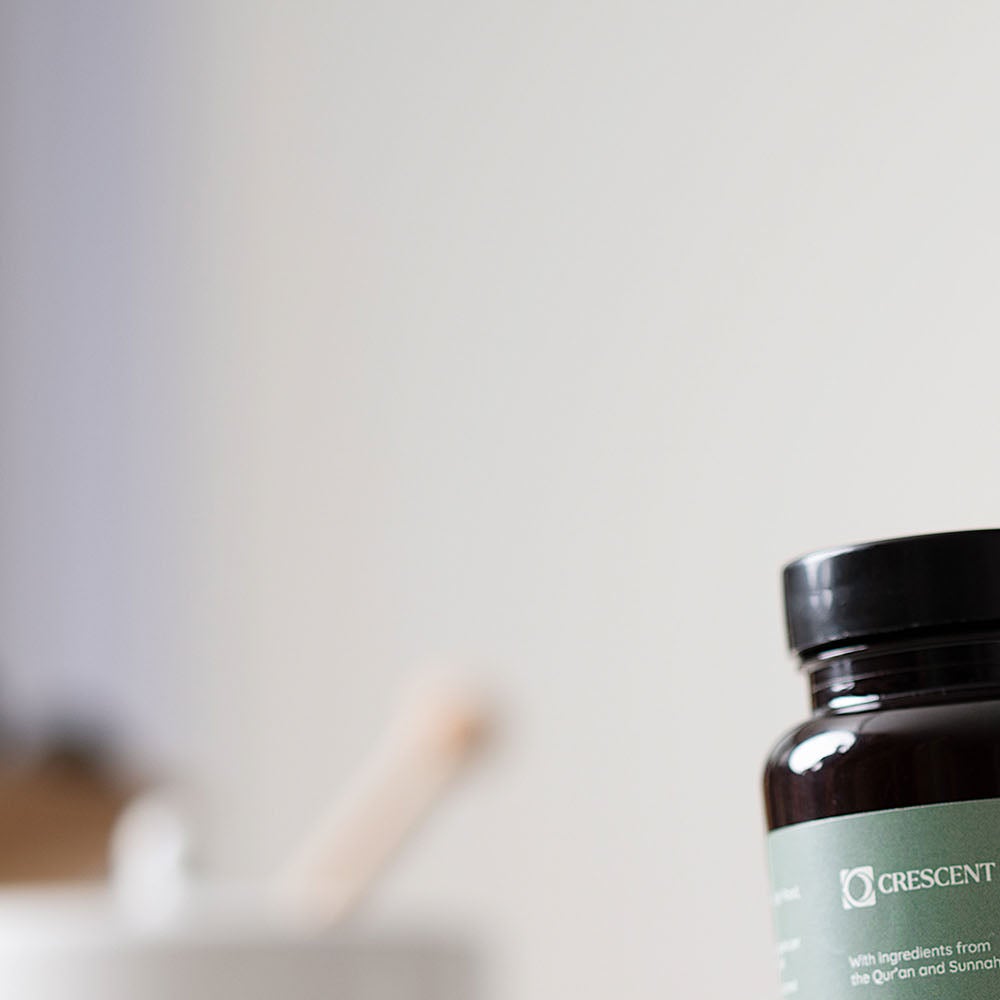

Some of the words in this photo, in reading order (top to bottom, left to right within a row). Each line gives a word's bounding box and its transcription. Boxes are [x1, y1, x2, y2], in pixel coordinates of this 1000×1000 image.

[878, 862, 996, 894] CRESCENT
[878, 944, 953, 966] ingredients
[956, 941, 991, 954] from
[850, 971, 870, 986] the
[919, 962, 945, 977] and
